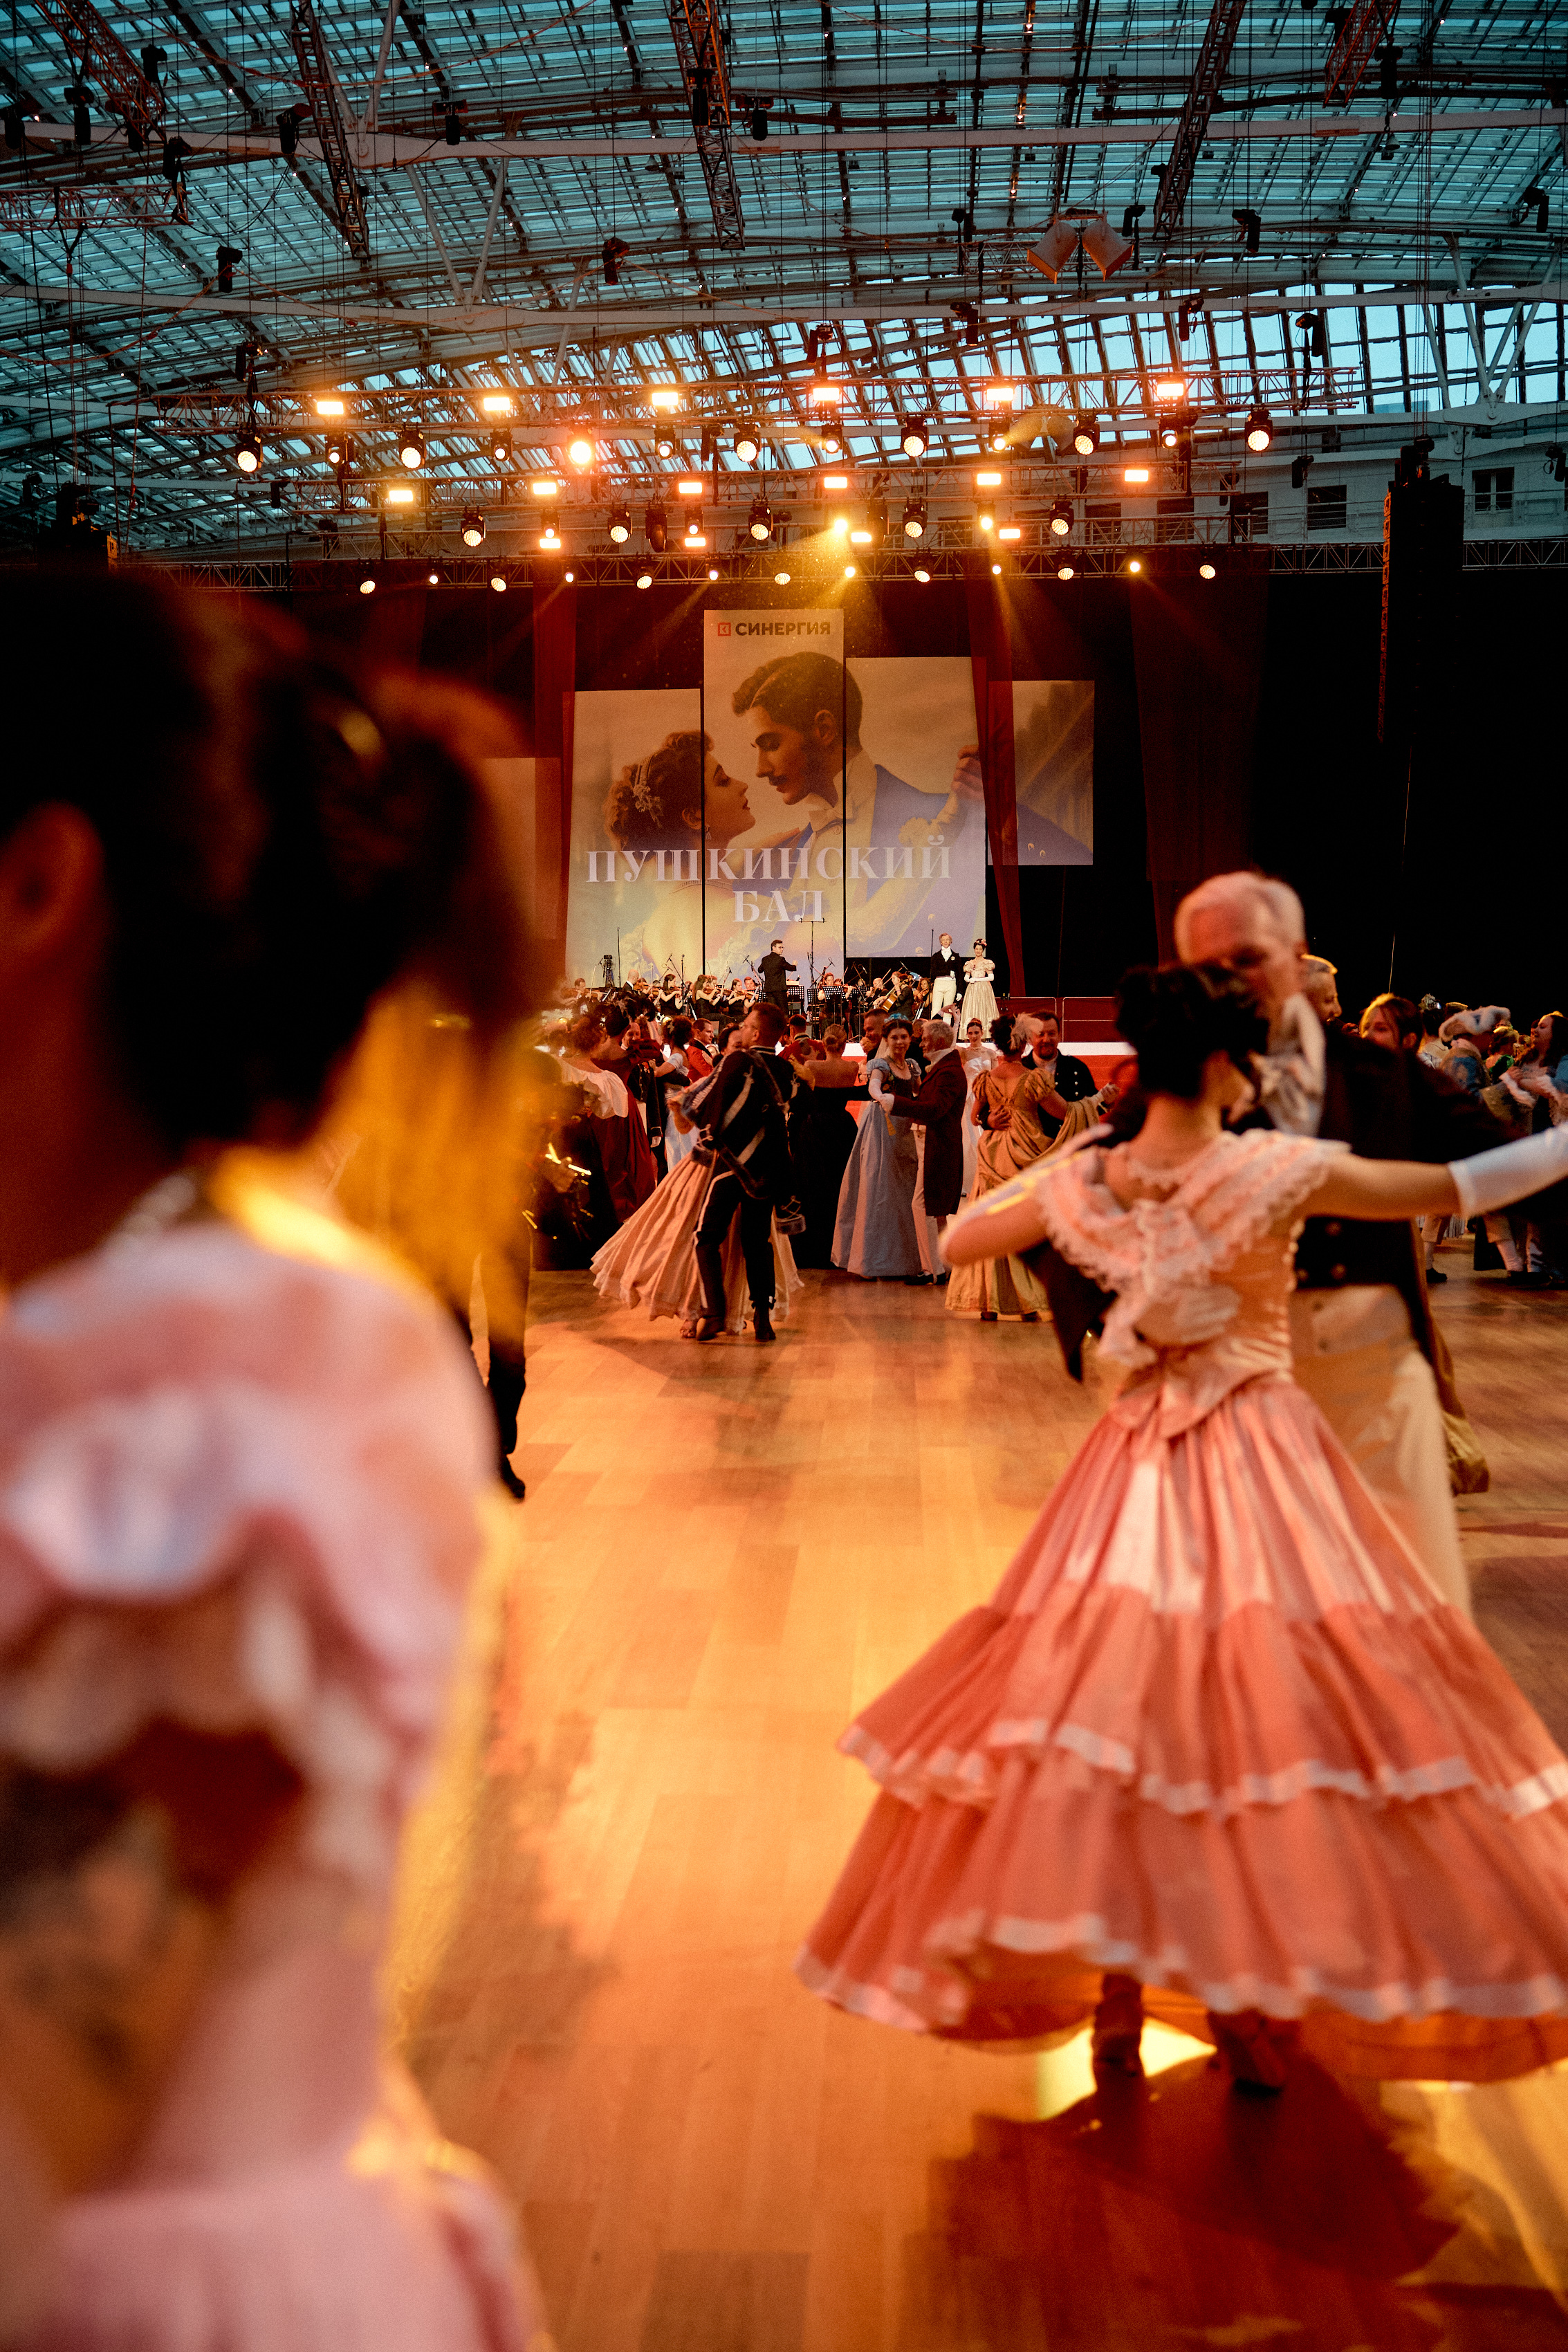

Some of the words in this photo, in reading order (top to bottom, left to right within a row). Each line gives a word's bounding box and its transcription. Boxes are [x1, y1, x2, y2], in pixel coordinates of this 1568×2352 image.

[735, 622, 831, 636] СИНЕРГИЯ
[586, 834, 952, 883] ПУШКИНСКИЙ
[732, 890, 824, 923] БАЛ
